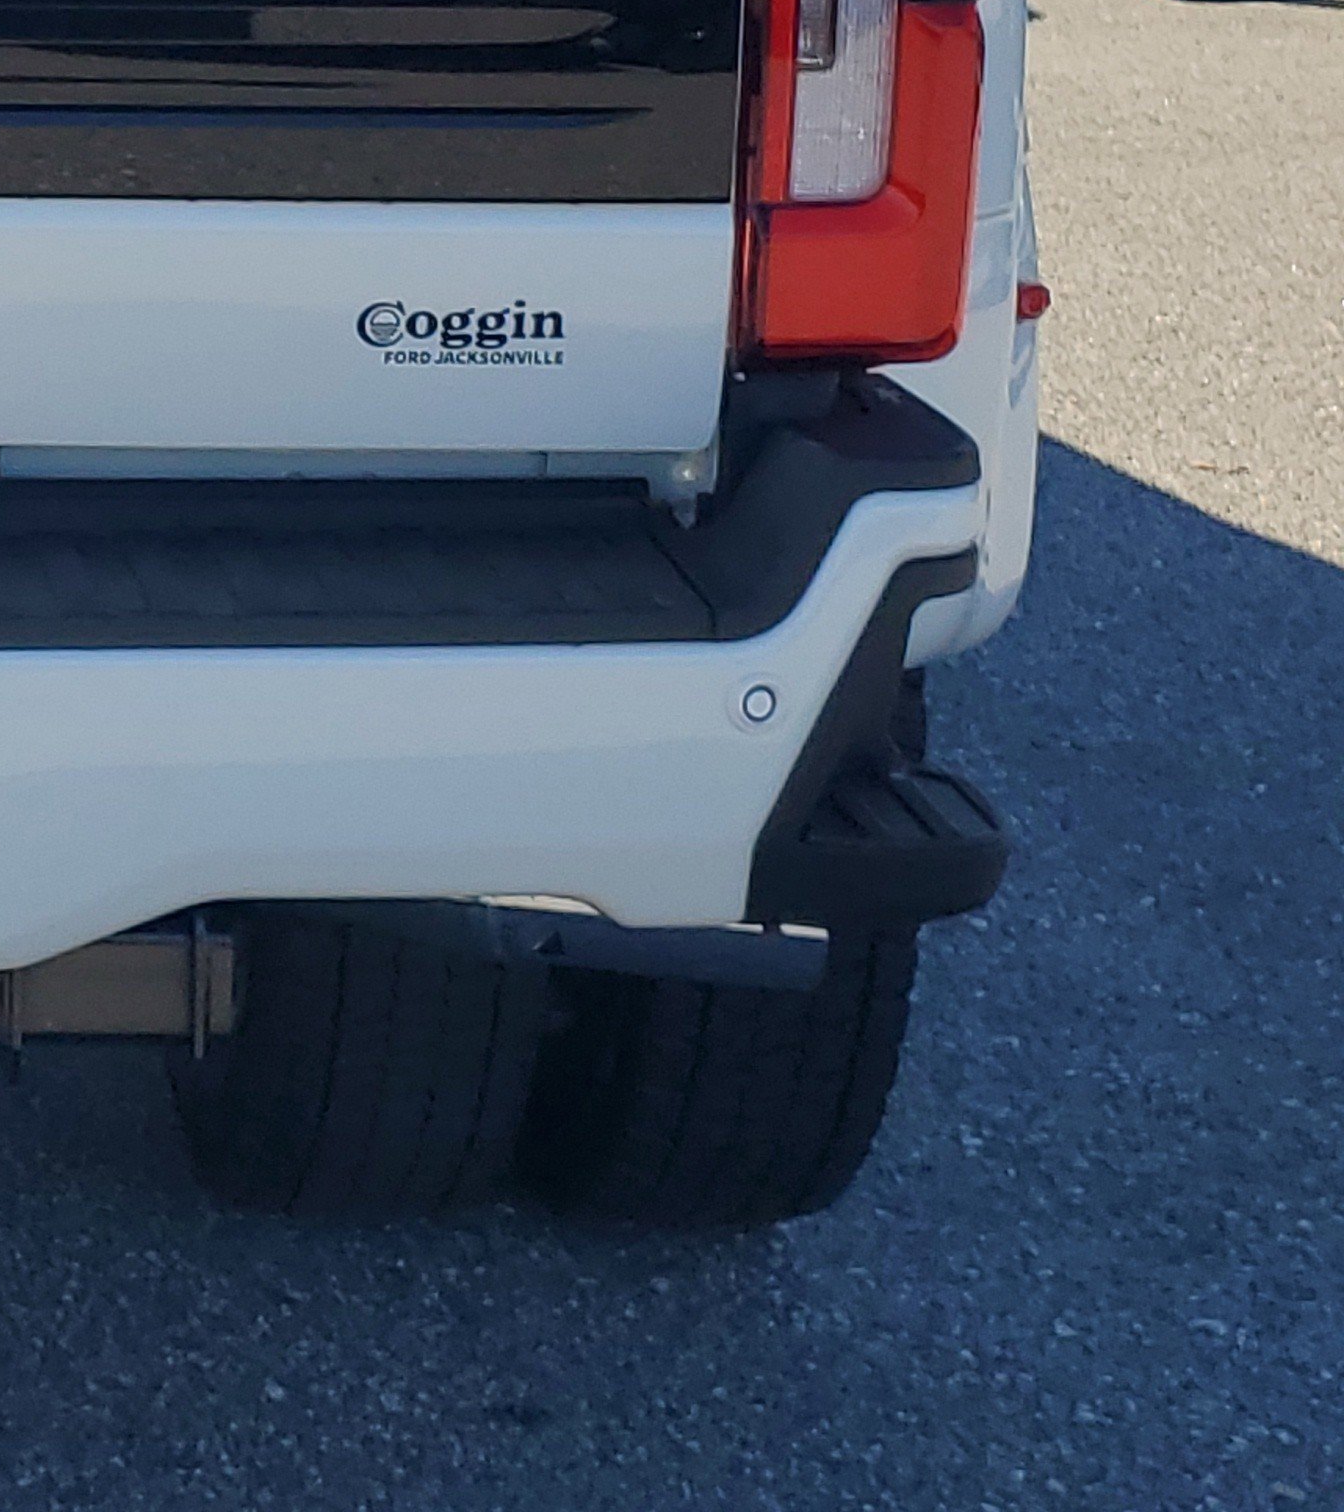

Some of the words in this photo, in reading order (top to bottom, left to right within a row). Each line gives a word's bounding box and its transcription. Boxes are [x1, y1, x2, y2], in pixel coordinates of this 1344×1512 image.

[357, 299, 566, 349] Coggin
[384, 351, 431, 365] FORD
[434, 351, 564, 365] JACKSONVILLE
